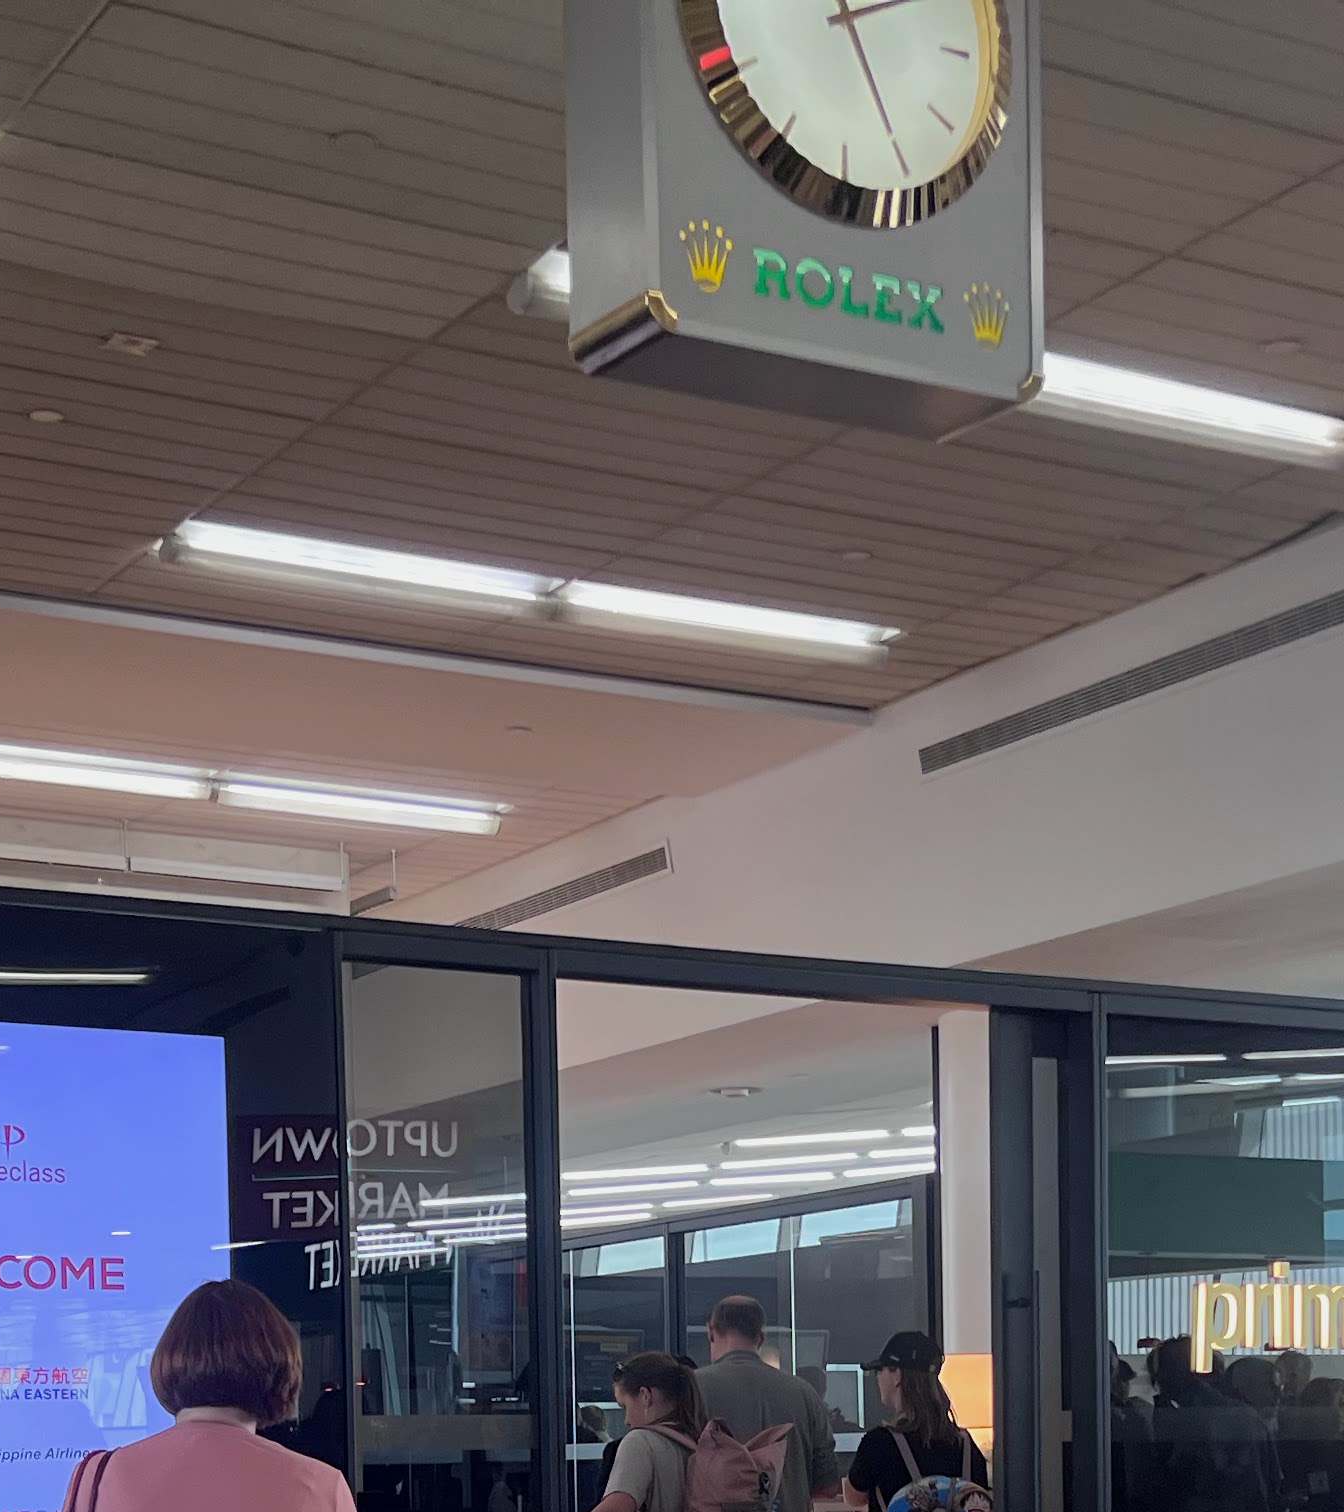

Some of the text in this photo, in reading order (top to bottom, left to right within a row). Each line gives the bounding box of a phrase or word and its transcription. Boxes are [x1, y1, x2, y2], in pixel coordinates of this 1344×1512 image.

[753, 248, 945, 334] ROLEX
[24, 1388, 89, 1401] EASTERN
[44, 1447, 90, 1461] Airline
